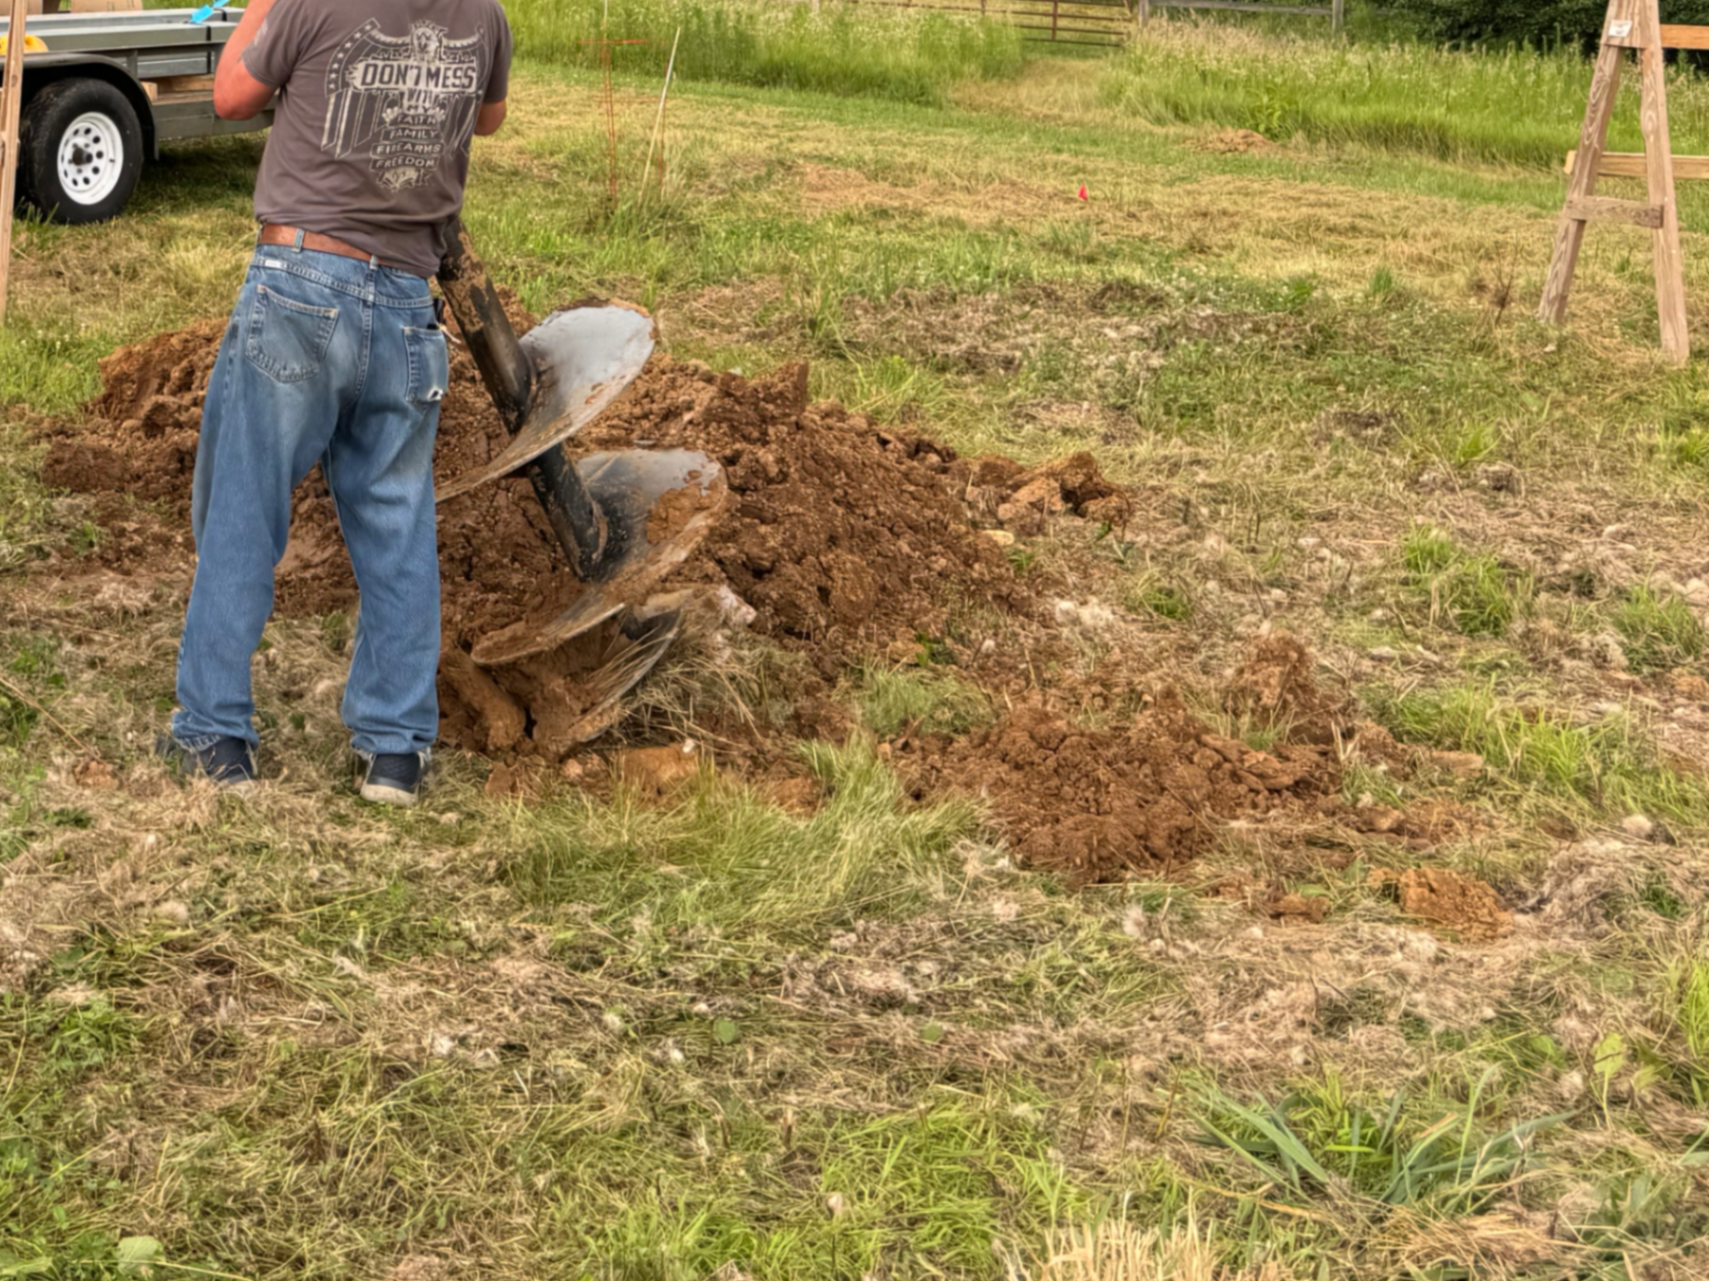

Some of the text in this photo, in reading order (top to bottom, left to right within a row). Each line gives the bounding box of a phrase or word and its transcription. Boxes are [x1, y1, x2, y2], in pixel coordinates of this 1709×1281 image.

[426, 65, 477, 90] MESS
[397, 114, 437, 124] FAITH
[390, 129, 439, 139] FAMILY
[376, 144, 442, 154] FIREARMS
[376, 157, 435, 169] FREEDOM
